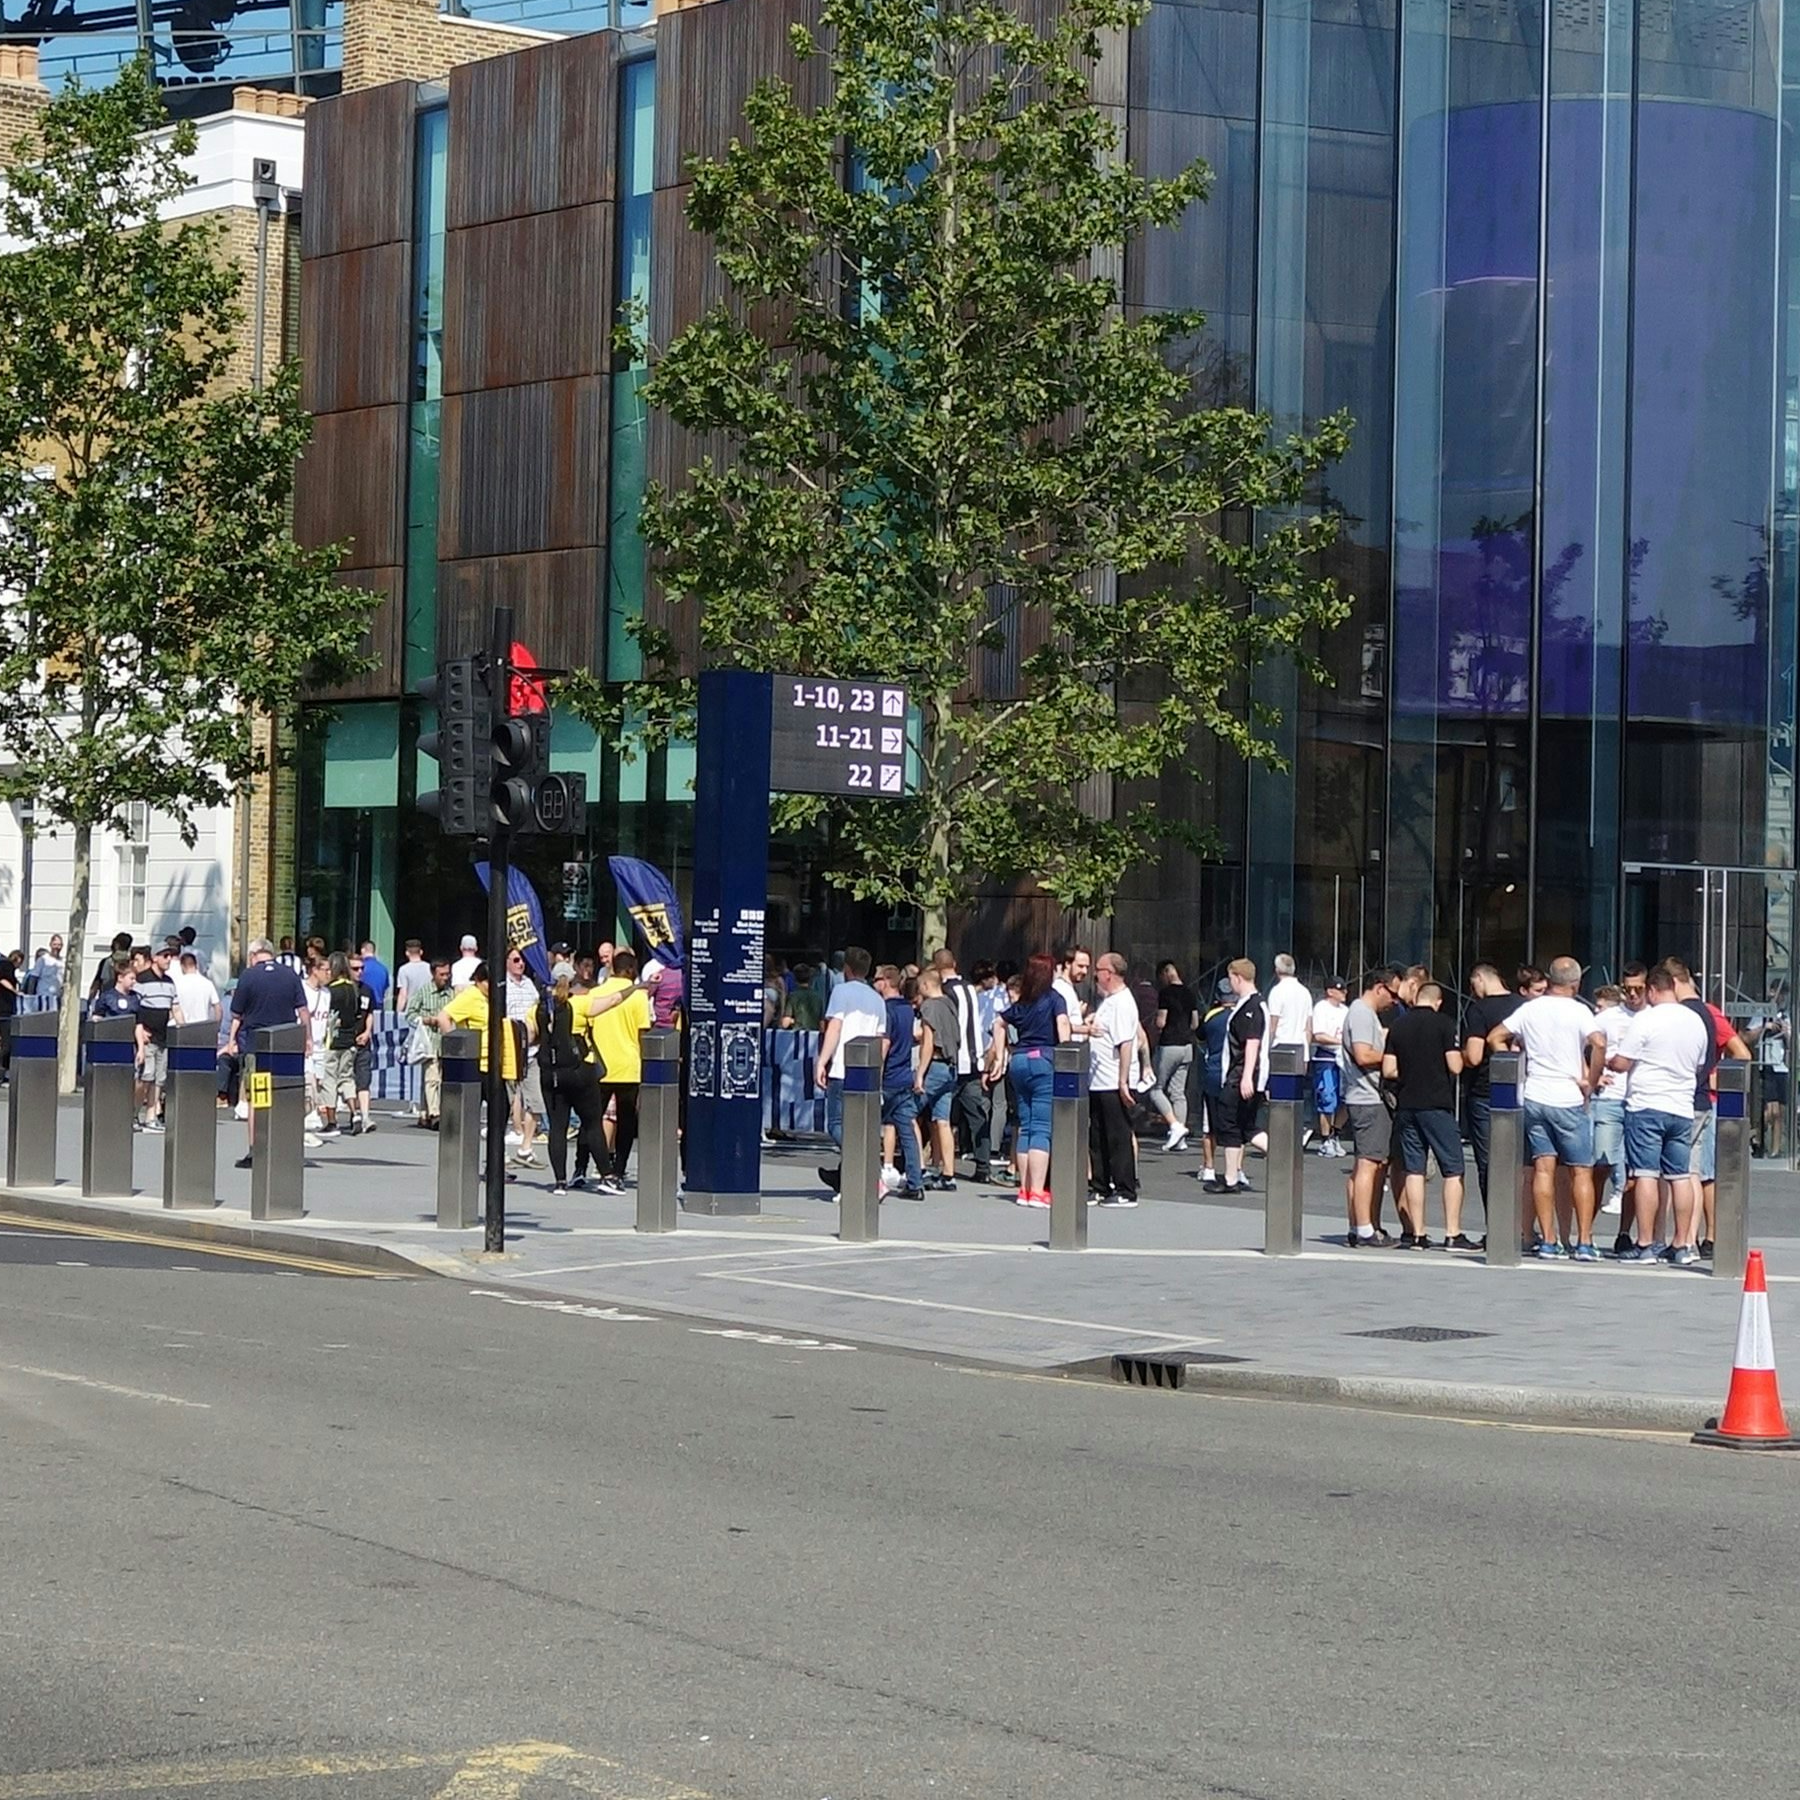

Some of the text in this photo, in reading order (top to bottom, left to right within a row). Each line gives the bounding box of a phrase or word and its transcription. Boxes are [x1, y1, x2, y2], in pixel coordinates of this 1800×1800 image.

[793, 684, 875, 713] 1-10, 23
[816, 724, 874, 750] 11-21
[848, 764, 873, 787] 22
[254, 1076, 268, 1104] H
